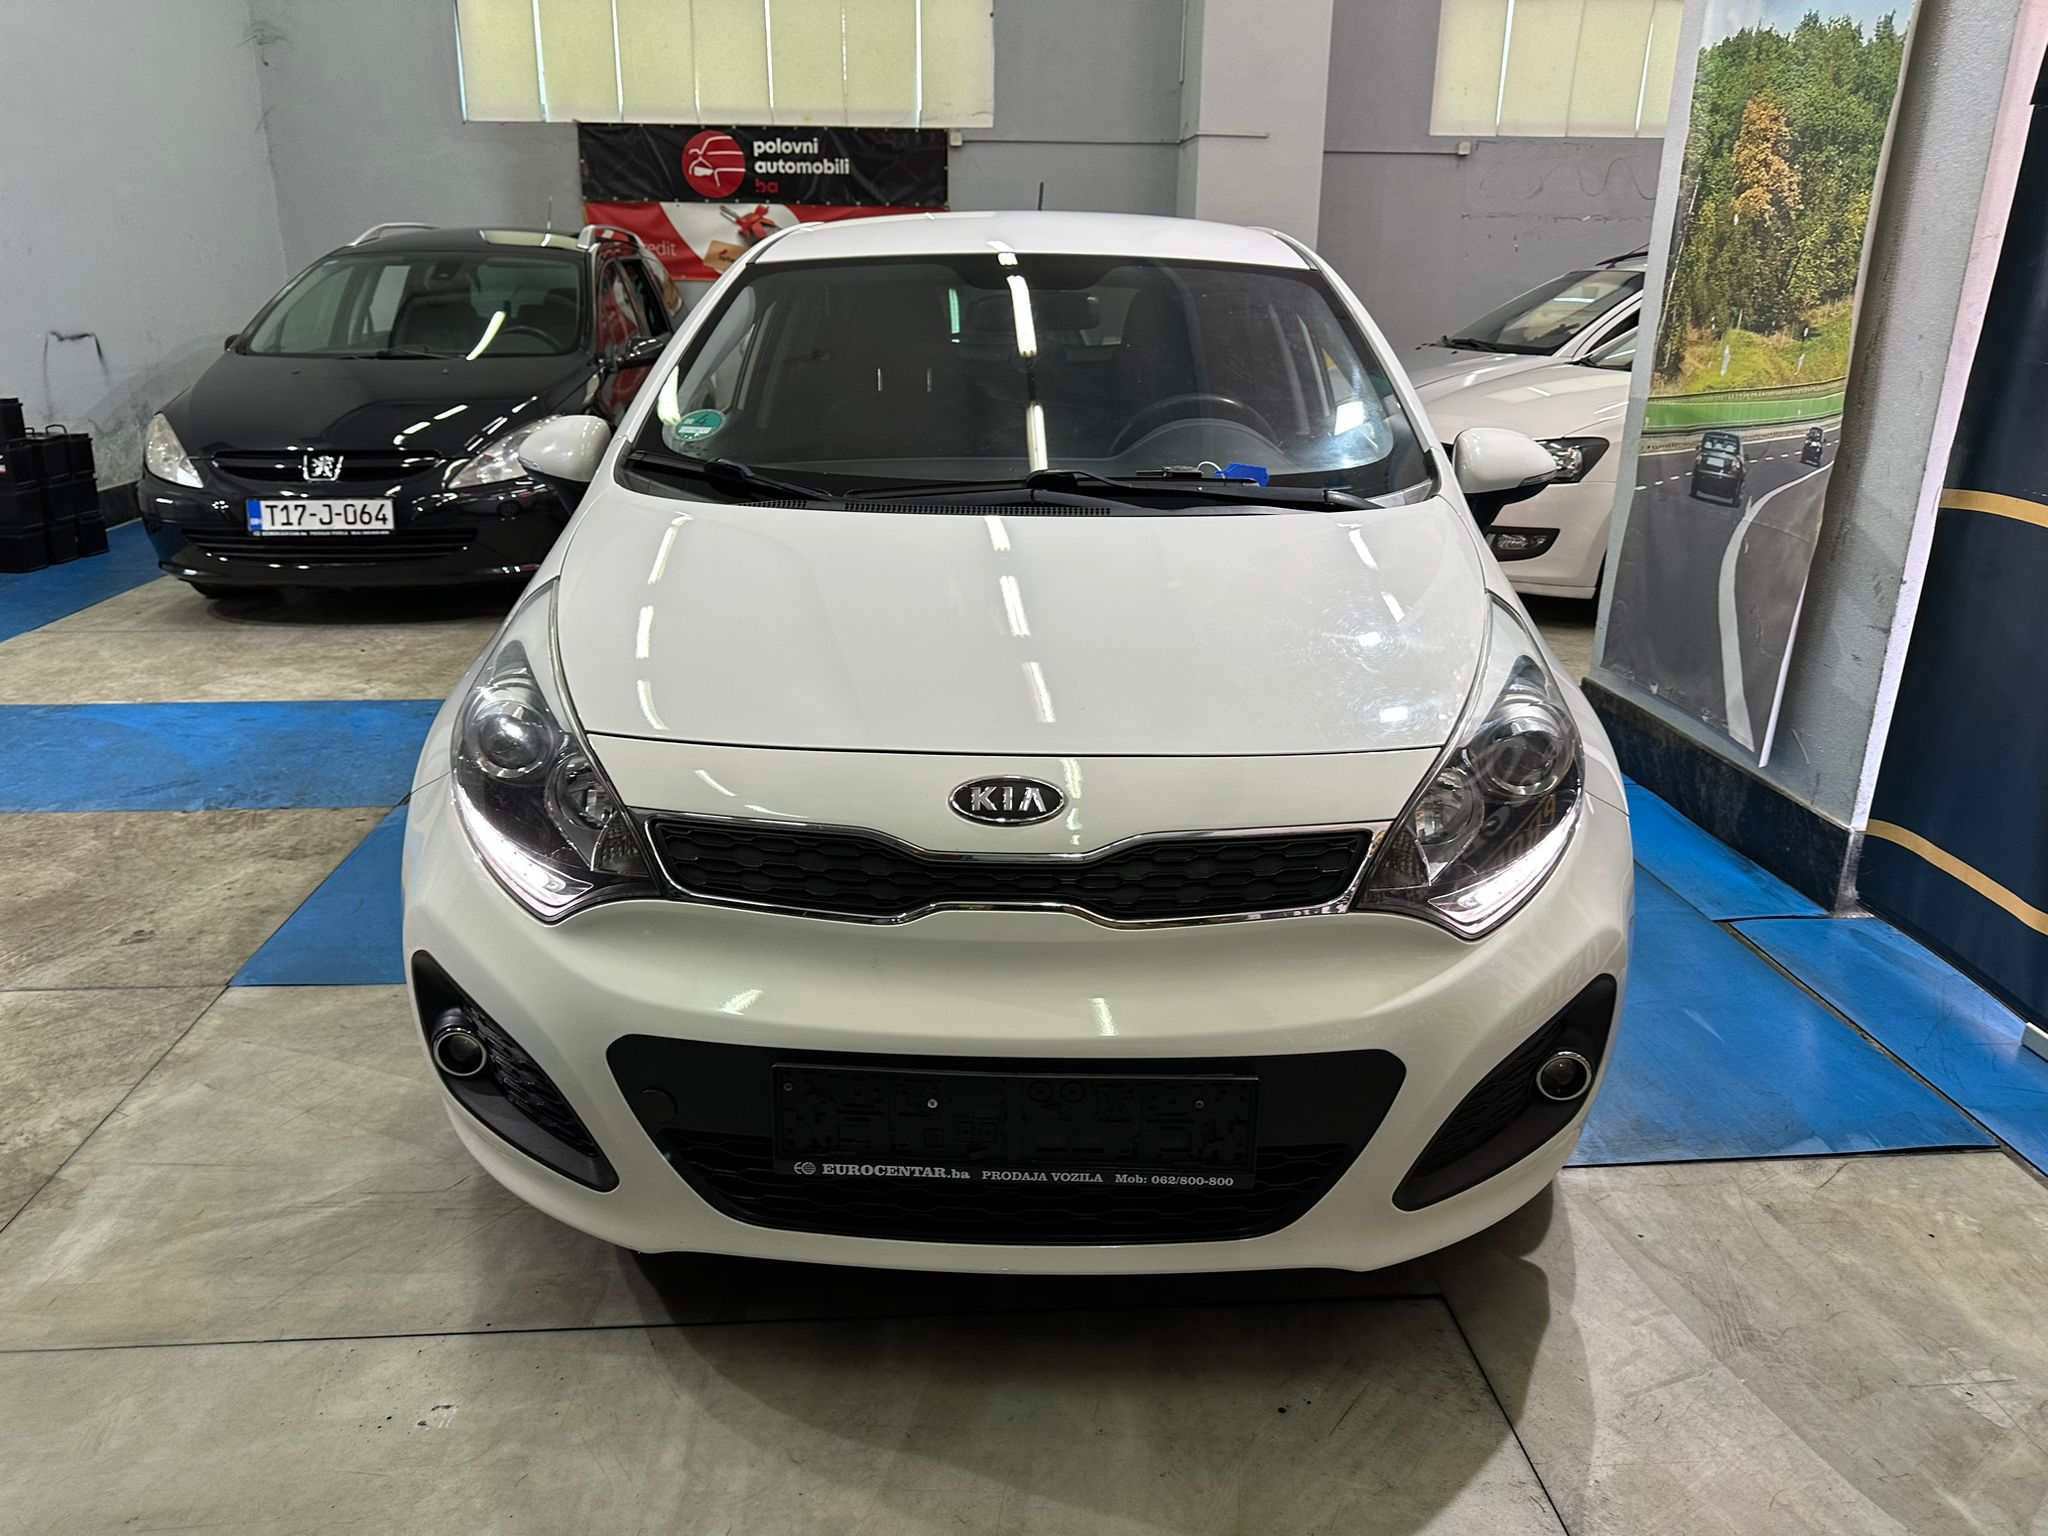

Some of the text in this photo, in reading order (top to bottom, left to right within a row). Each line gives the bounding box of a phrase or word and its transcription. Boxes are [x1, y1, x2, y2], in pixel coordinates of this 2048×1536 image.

[753, 137, 819, 157] polovni
[754, 158, 850, 175] automobili
[264, 503, 389, 526] T17-J-064
[970, 786, 1047, 813] KIA
[822, 1163, 1234, 1187] EUROCENTAR.ba PRODAJA VOZILA Mob: 062/800-800
